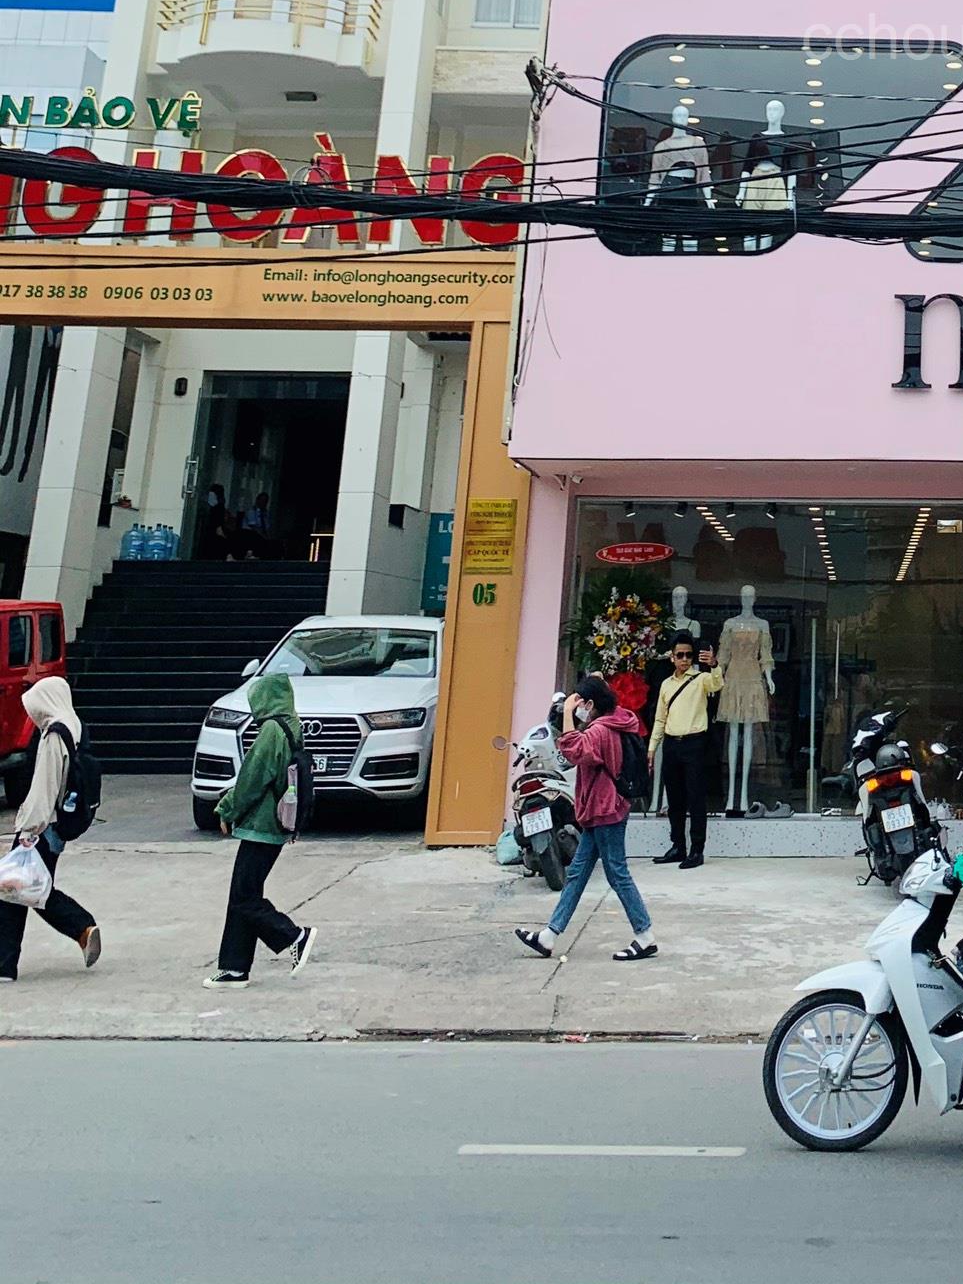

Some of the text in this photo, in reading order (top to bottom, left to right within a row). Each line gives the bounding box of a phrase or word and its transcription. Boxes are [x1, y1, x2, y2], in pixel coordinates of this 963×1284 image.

[44, 86, 136, 129] BẢO
[147, 91, 202, 137] VỆ
[263, 268, 308, 282] Email:
[25, 285, 44, 298] 38
[47, 285, 66, 299] 38
[69, 285, 88, 299] 38
[104, 286, 144, 300] 0906
[150, 287, 169, 301] 03
[172, 287, 191, 301] 03
[195, 287, 213, 301] 03
[262, 290, 469, 307] www. baovelonghoang.com
[473, 583, 497, 607] 05
